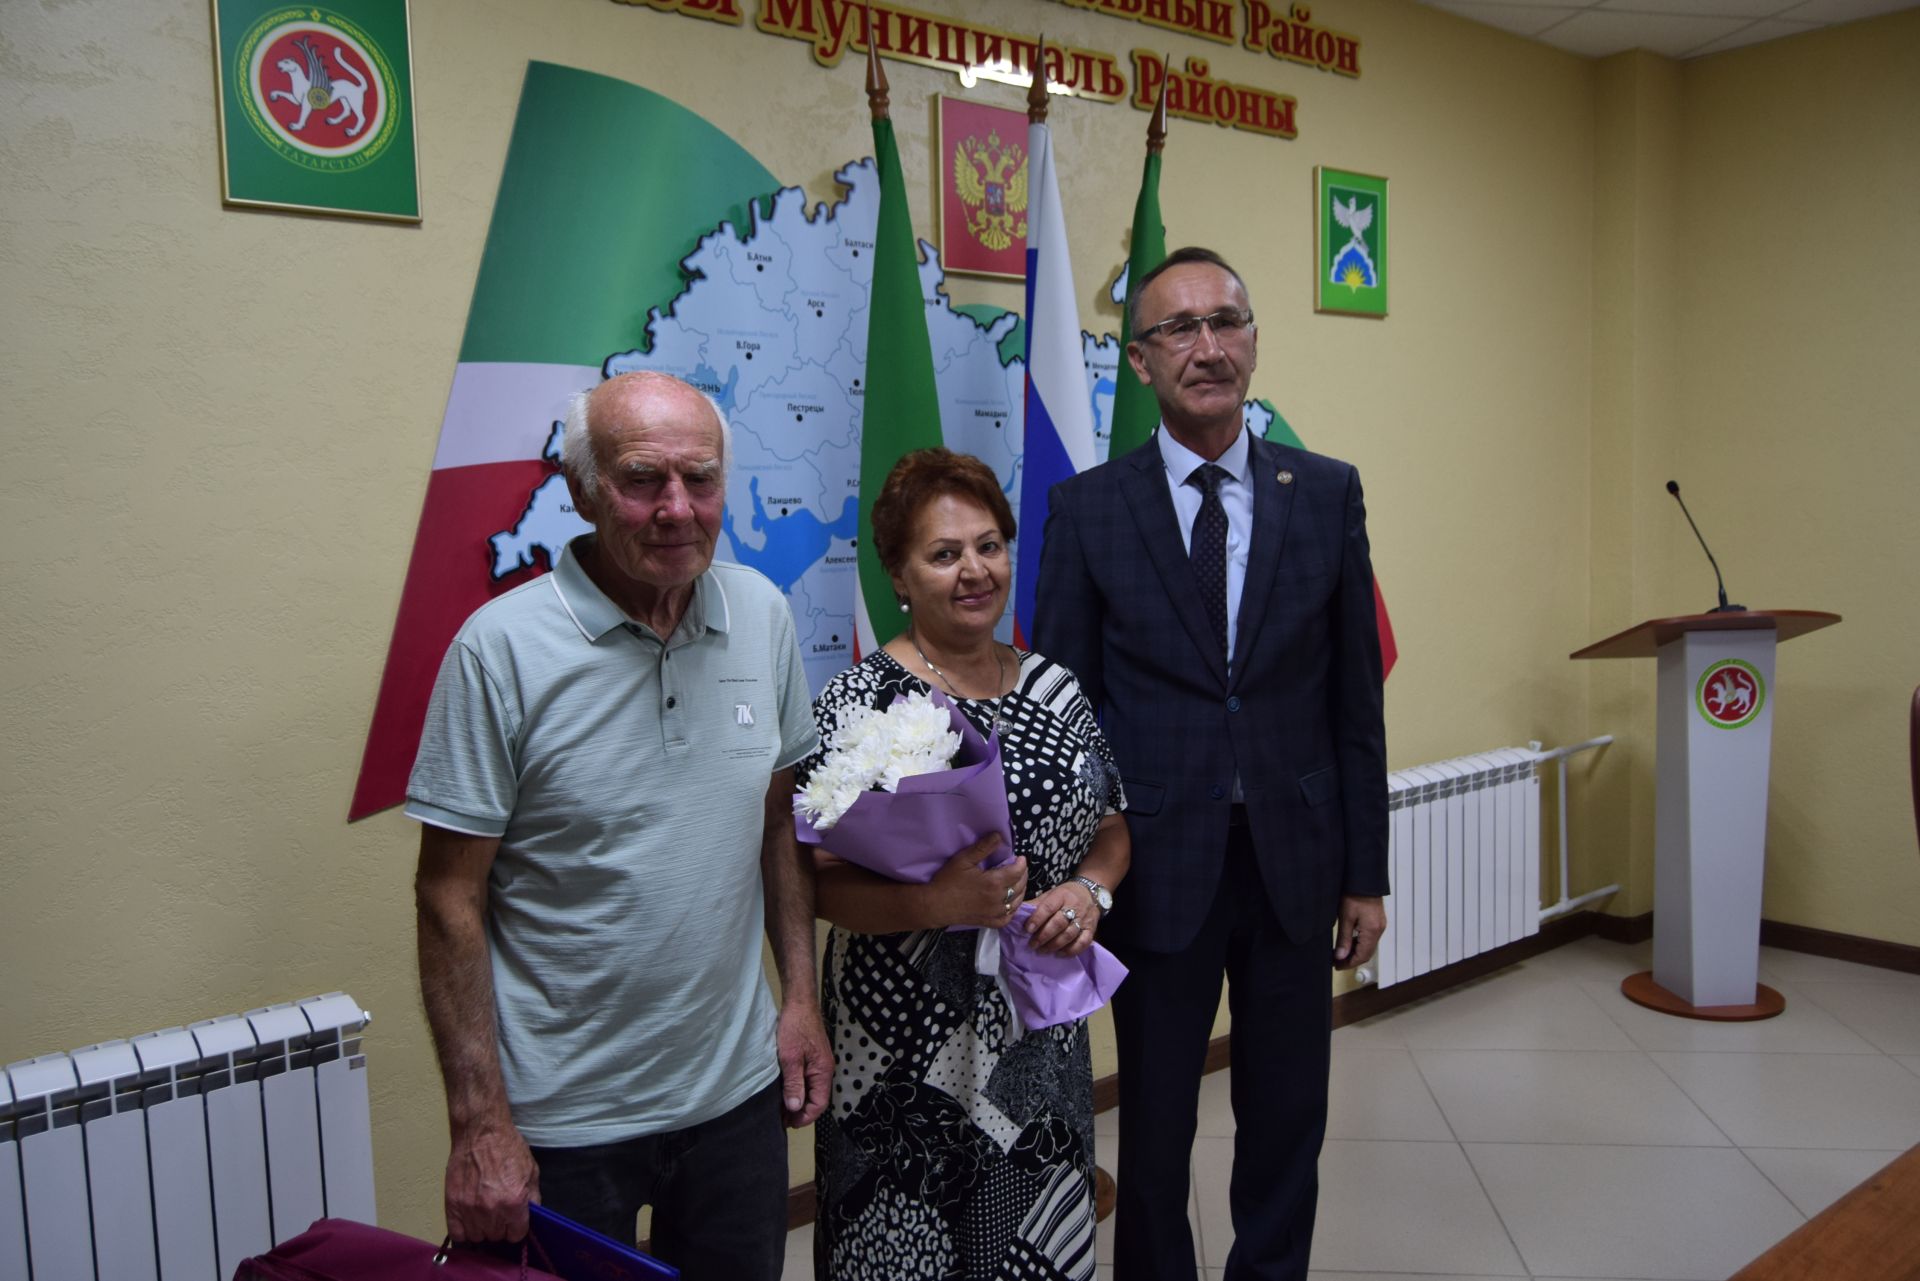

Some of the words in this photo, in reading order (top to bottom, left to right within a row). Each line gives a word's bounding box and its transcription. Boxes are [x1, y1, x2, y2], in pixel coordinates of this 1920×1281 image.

[1248, 0, 1360, 74] Район
[1137, 55, 1297, 134] Районы
[807, 298, 825, 309] Арск
[736, 340, 761, 352] В.Гора
[787, 403, 824, 414] Пестрецы
